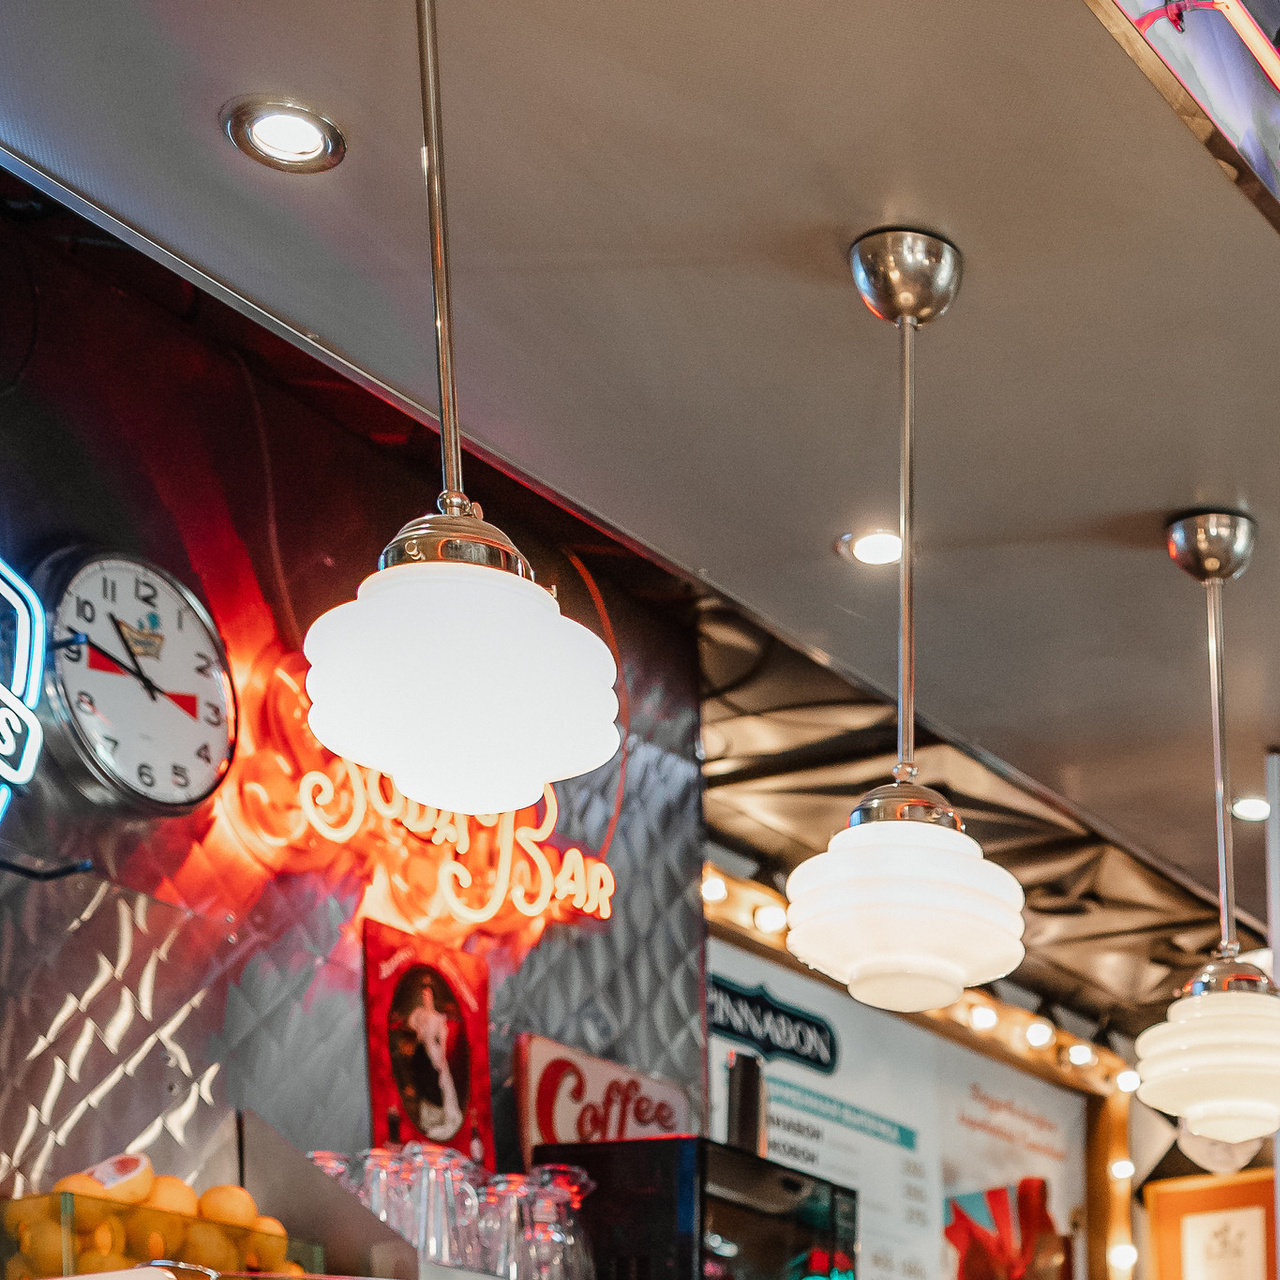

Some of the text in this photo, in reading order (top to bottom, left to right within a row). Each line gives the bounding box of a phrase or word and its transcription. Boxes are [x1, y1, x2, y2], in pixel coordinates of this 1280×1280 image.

[102, 577, 117, 603] 11
[134, 577, 158, 608] 12
[76, 596, 96, 624] 10
[194, 652, 213, 678] 2
[77, 690, 95, 715] 8
[204, 702, 222, 727] 3
[103, 734, 120, 754] 7
[195, 743, 212, 765] 4
[137, 763, 156, 788] 6
[171, 763, 190, 788] 5
[536, 1057, 676, 1142] Coffee
